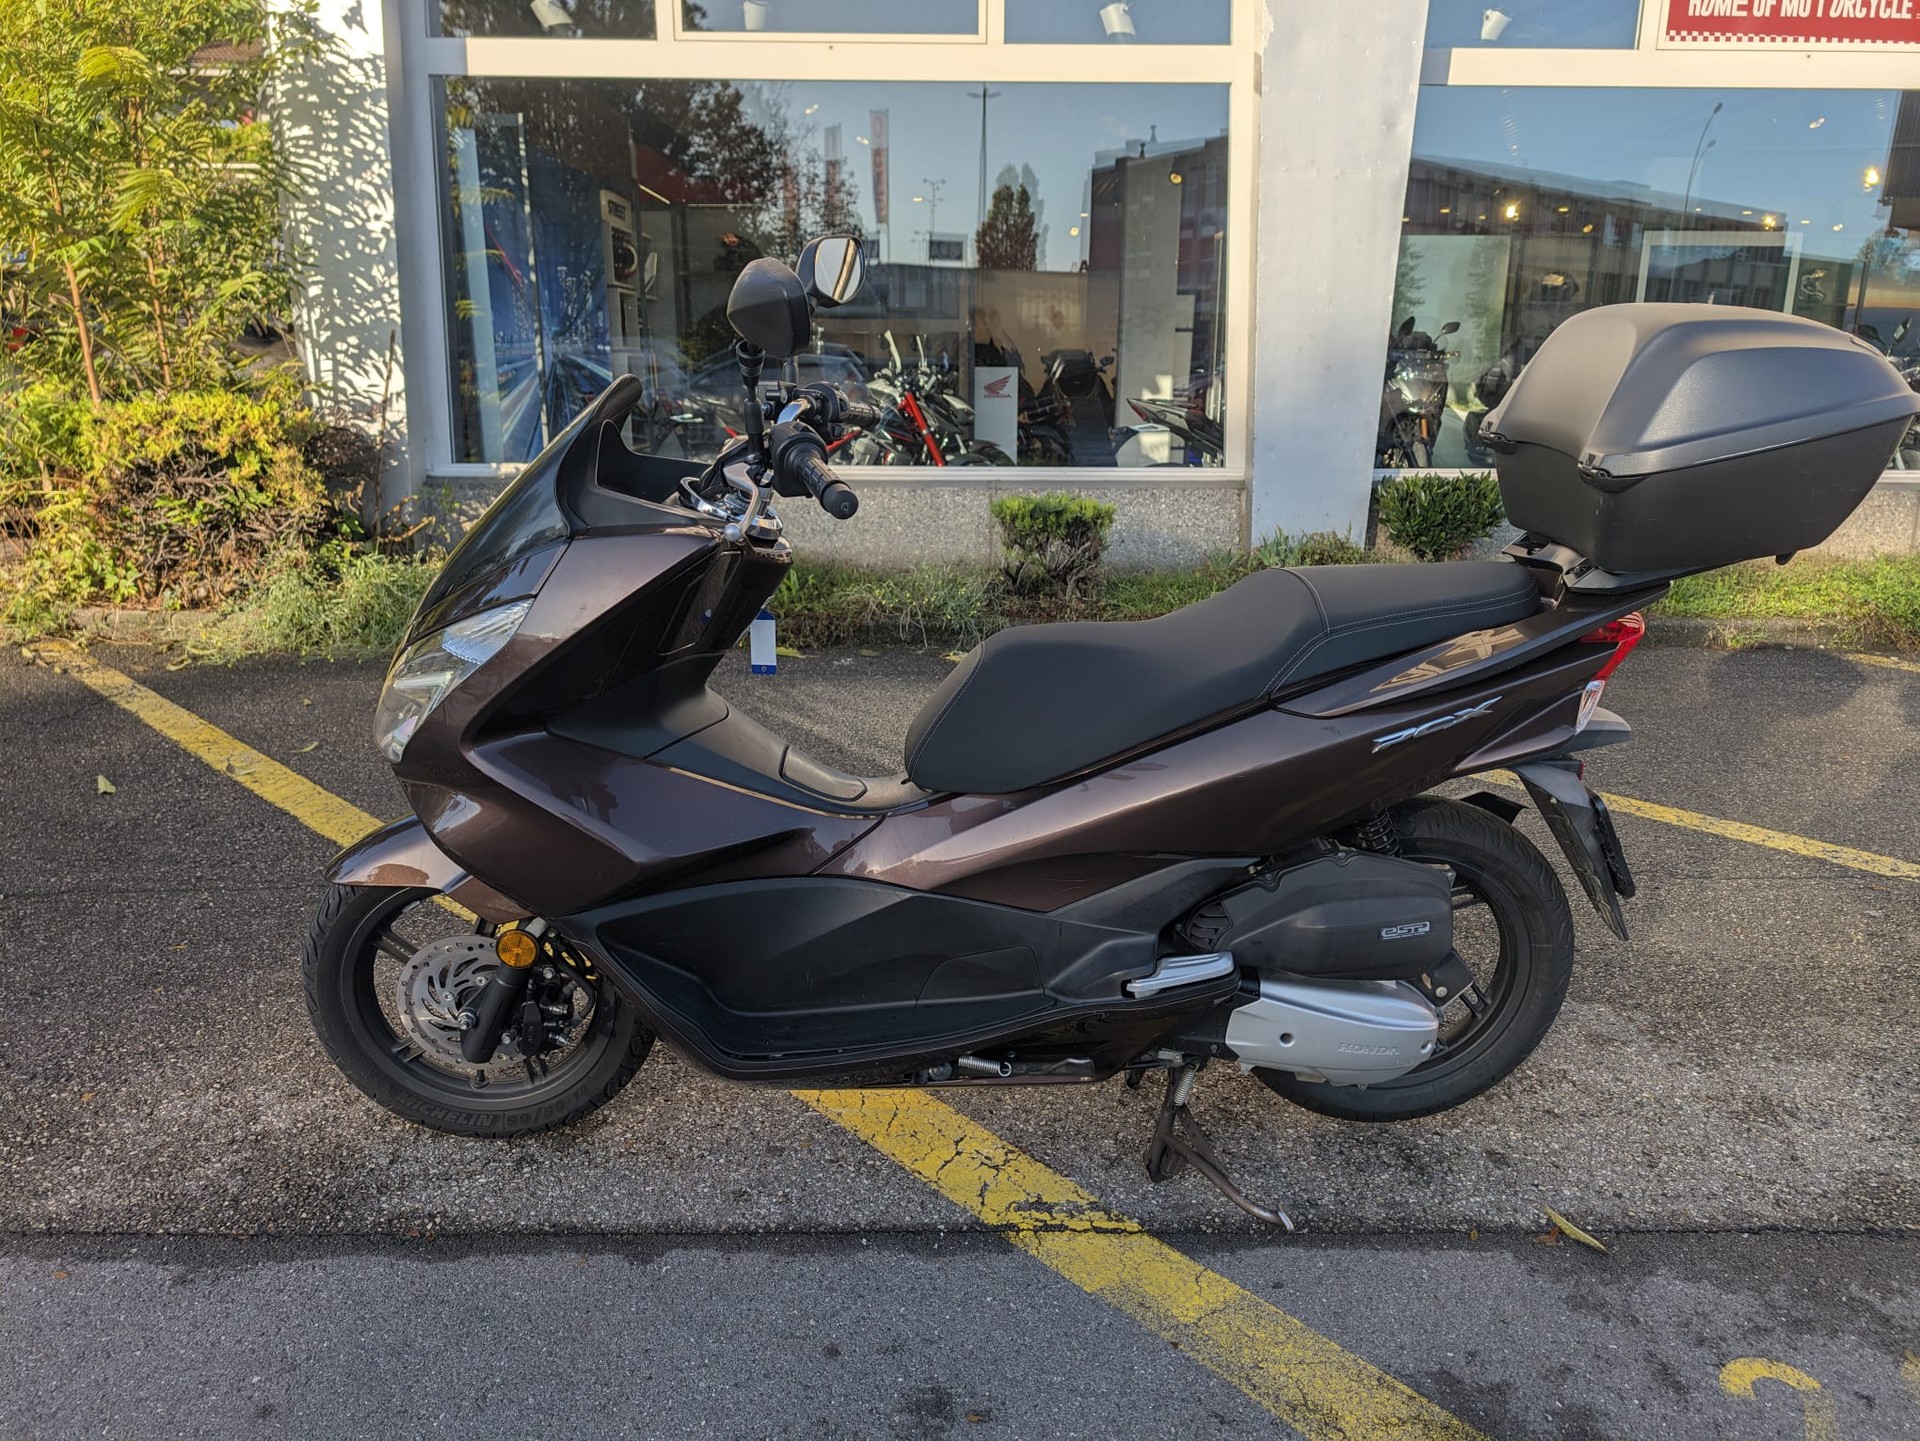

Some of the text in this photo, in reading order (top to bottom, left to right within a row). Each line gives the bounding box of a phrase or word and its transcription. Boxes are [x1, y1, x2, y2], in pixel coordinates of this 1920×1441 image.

[1688, 0, 1748, 17] HOME
[1752, 0, 1778, 17] OF
[1780, 0, 1913, 19] MOTORCYCLE
[1338, 1043, 1400, 1056] HONDA
[397, 1093, 494, 1127] MICHELIN
